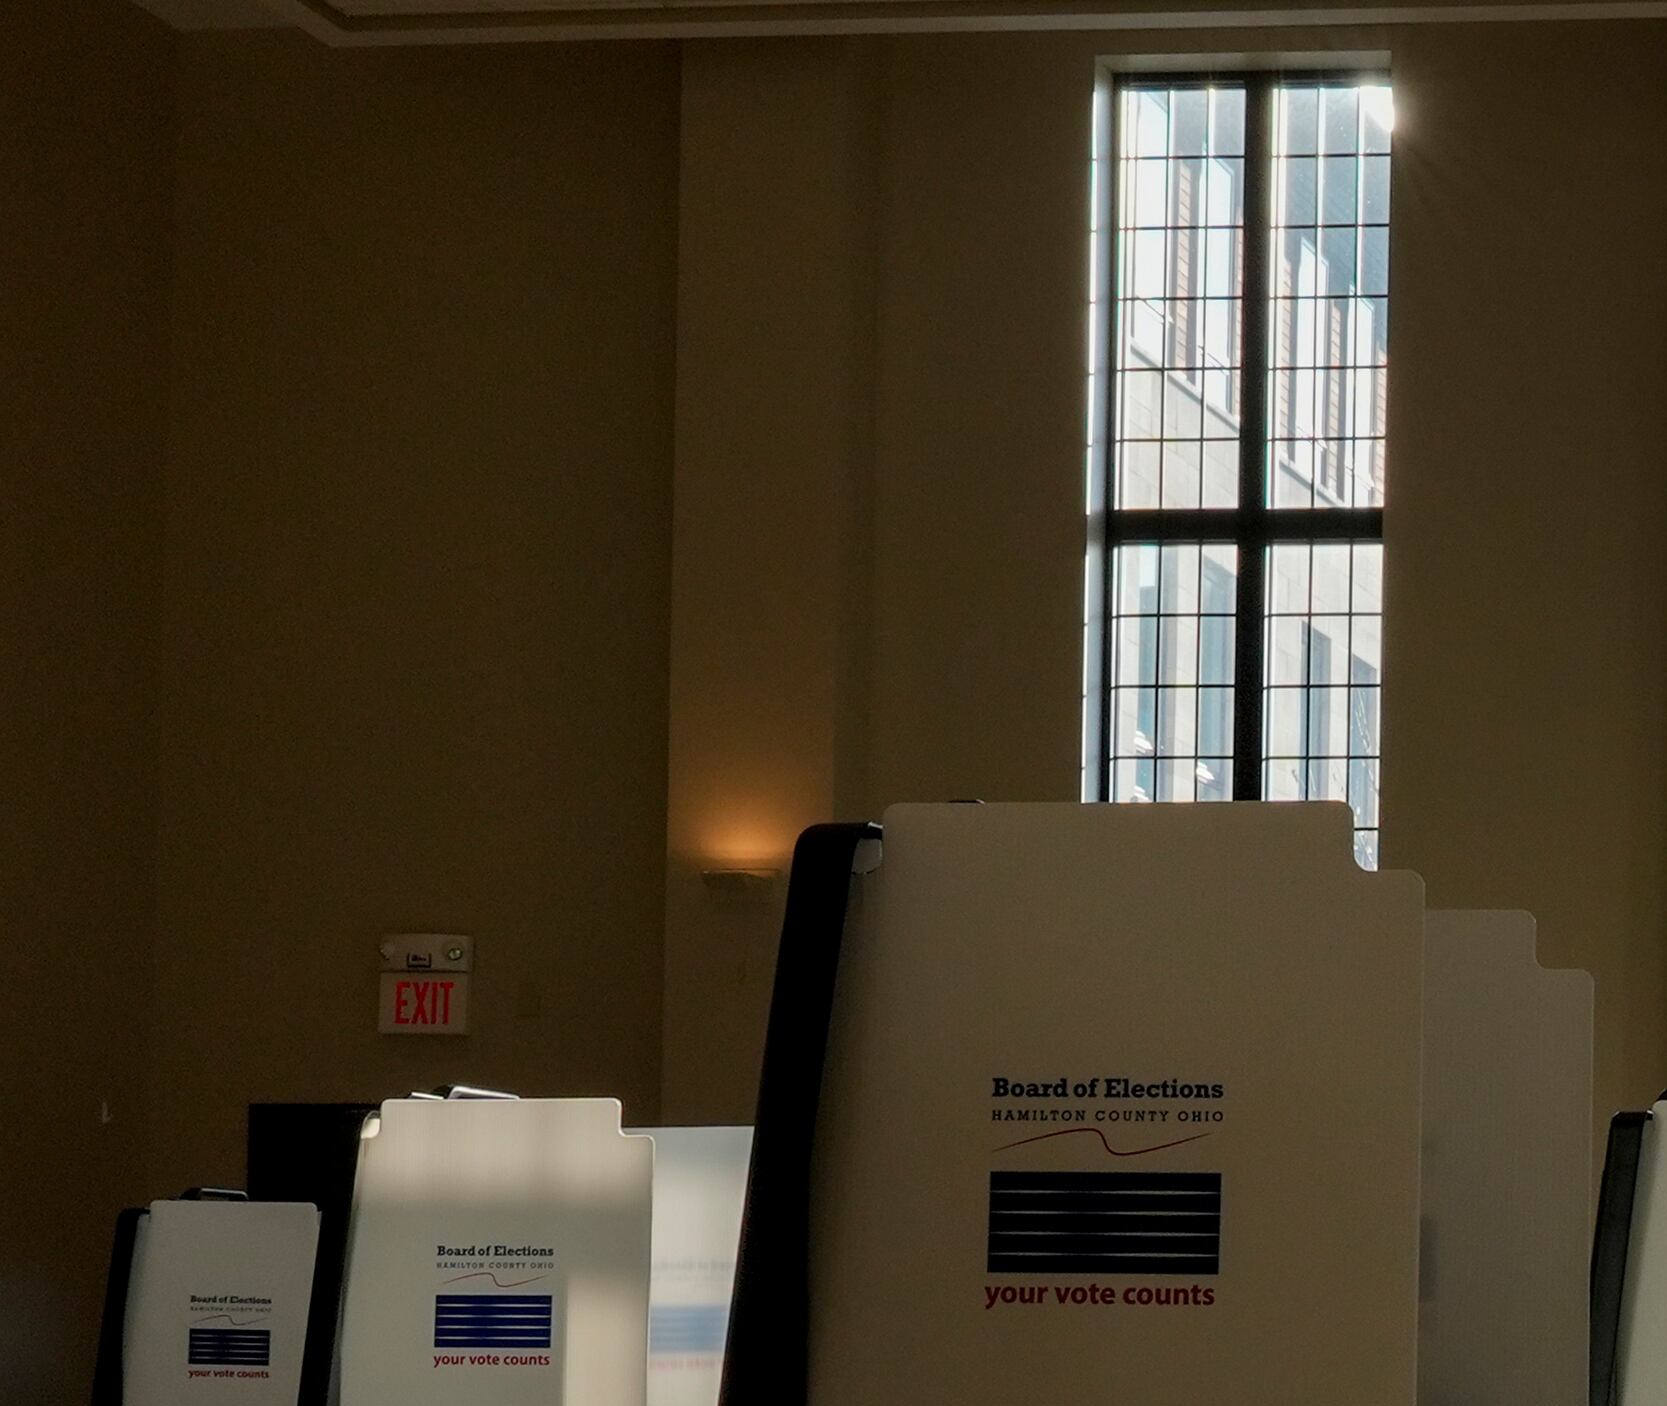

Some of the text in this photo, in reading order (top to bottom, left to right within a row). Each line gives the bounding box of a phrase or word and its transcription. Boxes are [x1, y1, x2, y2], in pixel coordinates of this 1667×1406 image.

[394, 982, 455, 1025] EXIT
[992, 1078, 1224, 1098] Board of Elections
[992, 1110, 1224, 1122] HAMILTON COUNTY OHIO
[437, 1245, 554, 1257] Board of Elections
[985, 1284, 1215, 1309] your vote counts
[433, 1354, 550, 1368] your vote counts
[188, 1369, 270, 1379] your vote counts
